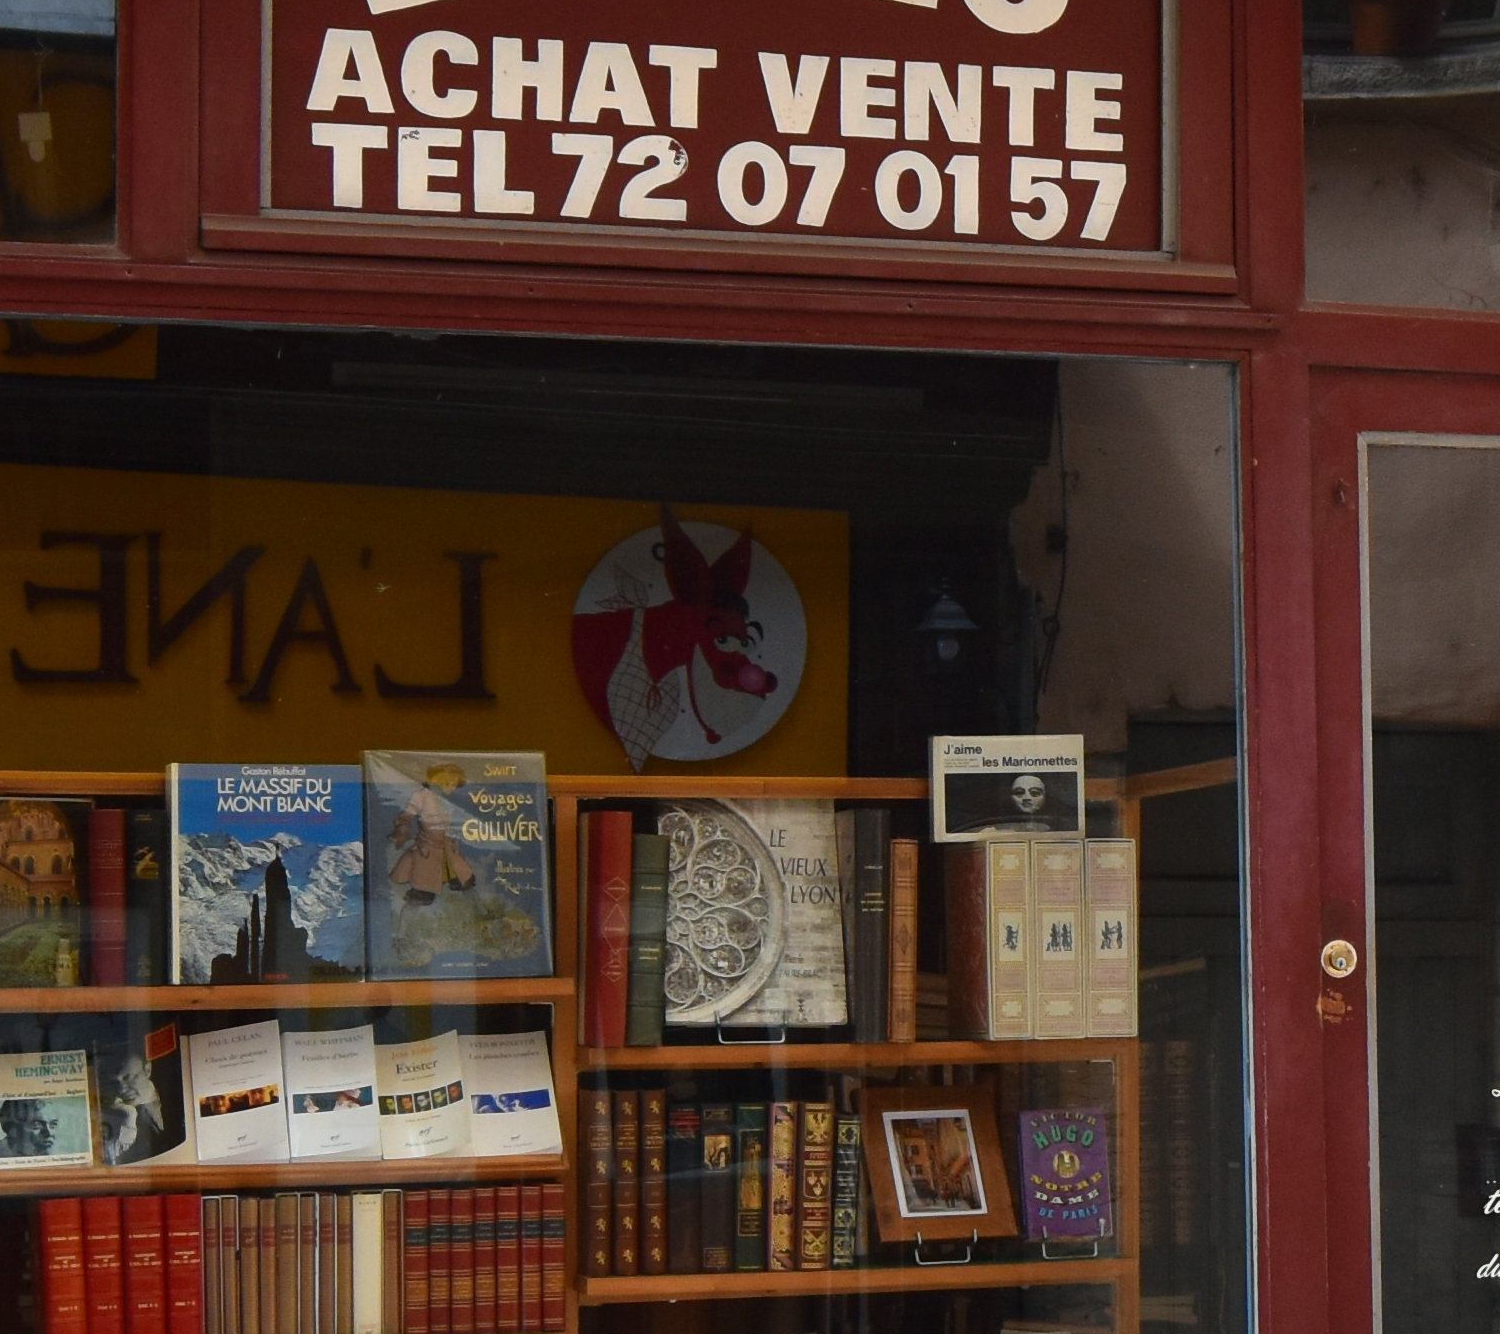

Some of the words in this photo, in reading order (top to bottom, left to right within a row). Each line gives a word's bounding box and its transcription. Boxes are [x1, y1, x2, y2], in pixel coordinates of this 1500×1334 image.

[306, 27, 718, 129] ACHAT
[757, 51, 1124, 152] VENTE
[311, 122, 534, 215] TEL
[550, 132, 689, 222] 72
[716, 139, 847, 227] 07
[873, 149, 981, 235] 01
[1007, 156, 1128, 242] 57
[944, 743, 983, 756] J'aime
[982, 757, 999, 768] les
[1002, 755, 1078, 768] Marionnettes
[217, 778, 236, 793] LE
[238, 777, 302, 794] MASSIF
[306, 777, 332, 793] DU
[217, 796, 275, 814] MONT
[277, 795, 332, 813] BLANC
[468, 790, 534, 814] Voyages
[461, 817, 543, 843] GULLIVER
[770, 828, 786, 848] LE
[780, 857, 828, 877] VIEUX
[790, 885, 838, 905] LYON
[207, 1037, 231, 1048] PAUL
[234, 1032, 262, 1043] CELAN
[40, 1053, 84, 1064] ERNEST
[395, 1058, 439, 1075] Exister
[14, 1064, 85, 1078] HEMINGWAY
[1030, 1110, 1098, 1128] VICTOR
[1032, 1124, 1095, 1149] HUGO
[1030, 1171, 1103, 1192] NOTRE
[1034, 1188, 1100, 1205] DAME
[1038, 1206, 1055, 1219] DE
[1062, 1204, 1098, 1219] PARIS
